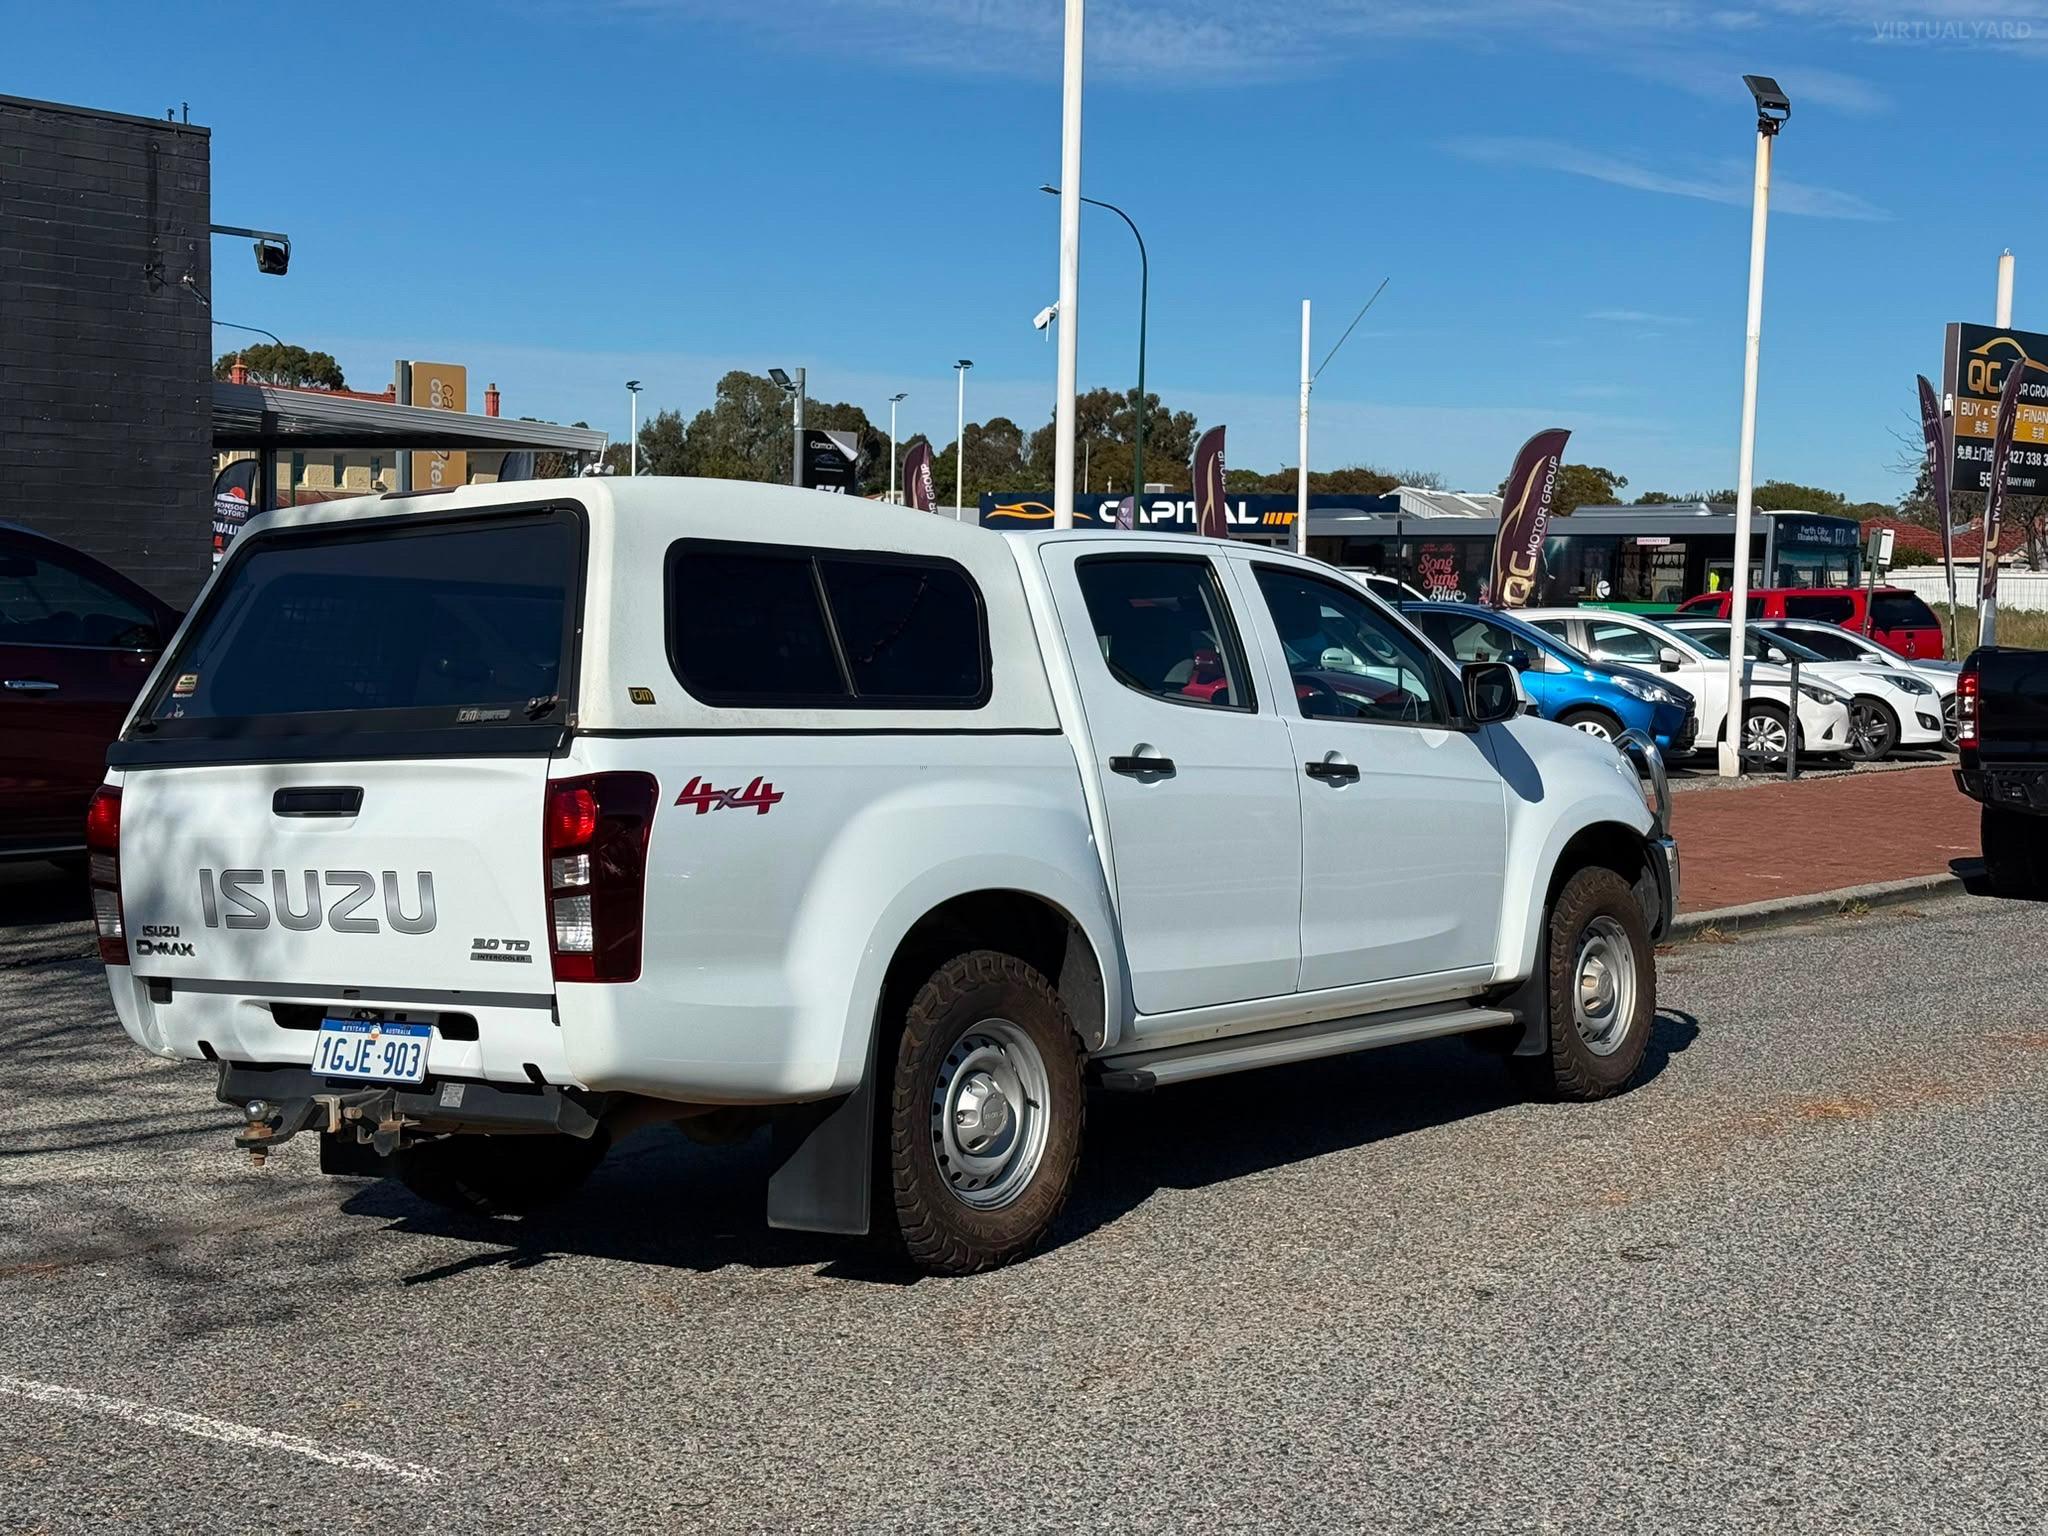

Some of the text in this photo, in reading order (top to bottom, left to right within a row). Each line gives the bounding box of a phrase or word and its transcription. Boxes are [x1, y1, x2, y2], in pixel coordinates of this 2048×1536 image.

[1968, 359, 2001, 394] QC
[2029, 384, 2048, 398] GRO
[1961, 401, 1980, 416] BUY
[2026, 453, 2041, 466] 338
[919, 463, 936, 499] GROUP
[2022, 478, 2036, 488] HWY
[217, 508, 245, 518] MOTORS
[1503, 455, 1559, 608] QC MOTOR GROUP
[1801, 525, 1829, 536] Perth City
[1418, 554, 1454, 574] Song
[1423, 570, 1459, 589] Sung
[1429, 585, 1467, 602] Blue
[674, 775, 785, 815] 4x4
[199, 868, 437, 935] ISUZU
[142, 925, 180, 938] ISUZU
[501, 940, 530, 951] TD
